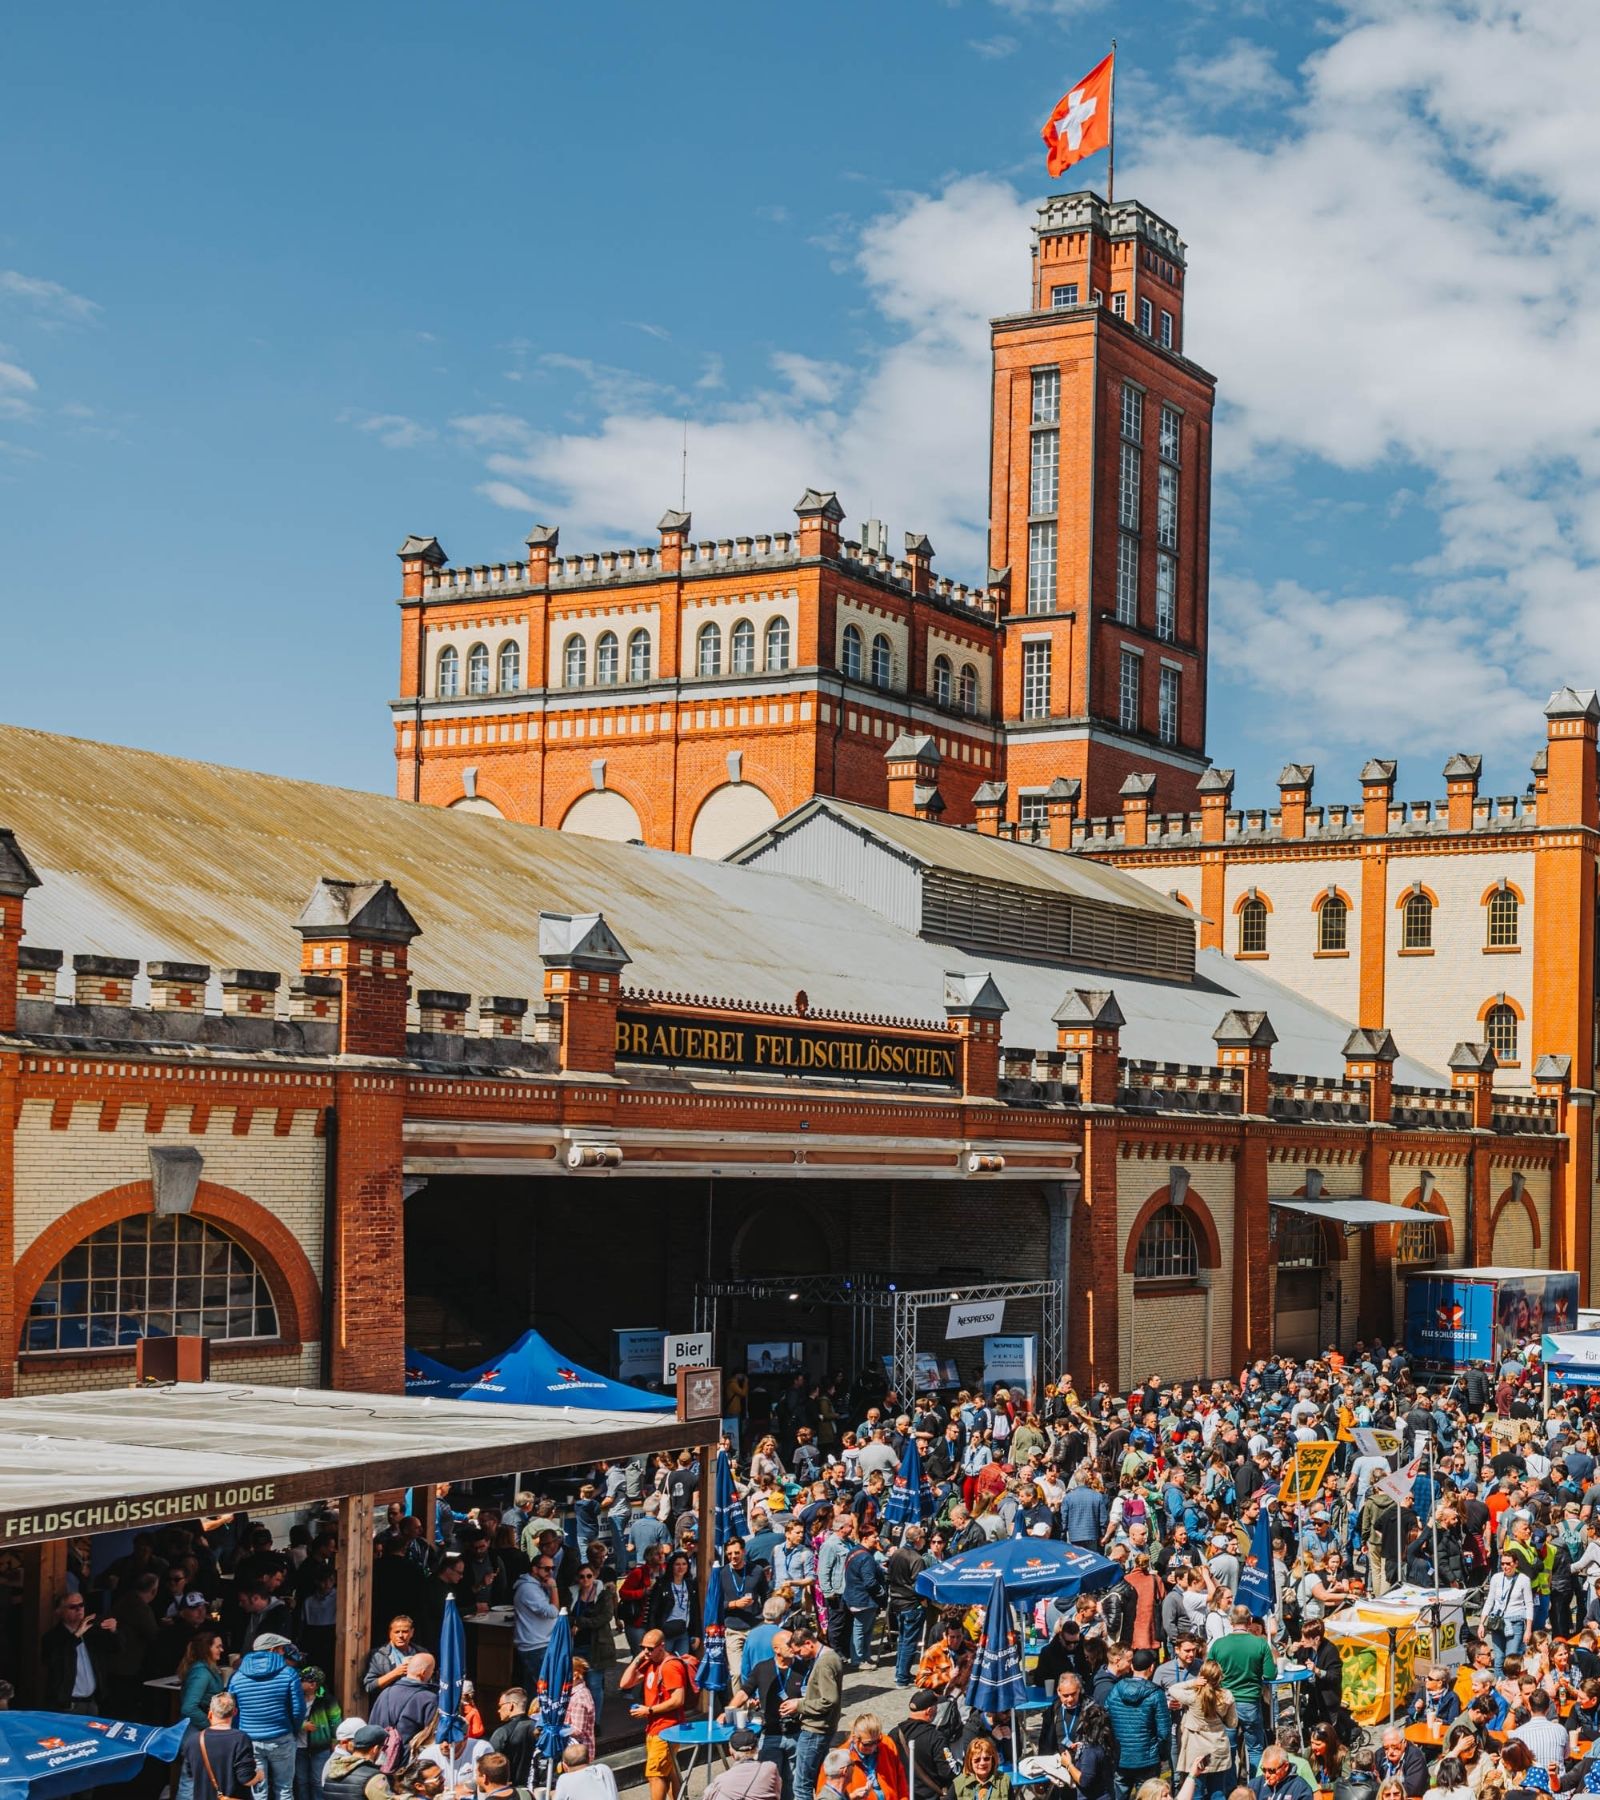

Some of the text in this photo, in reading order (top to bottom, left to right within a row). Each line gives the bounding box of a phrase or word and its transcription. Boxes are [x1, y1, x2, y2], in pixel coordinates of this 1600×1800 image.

[616, 1022, 955, 1078] BRAUEREI FELDSCHLÖSSCHEN
[958, 1313, 995, 1326] NESPRESSO
[676, 1341, 704, 1357] Bier
[1585, 1351, 1600, 1360] für
[5, 1483, 275, 1538] FELDSCHLÖSSCHEN LODGE
